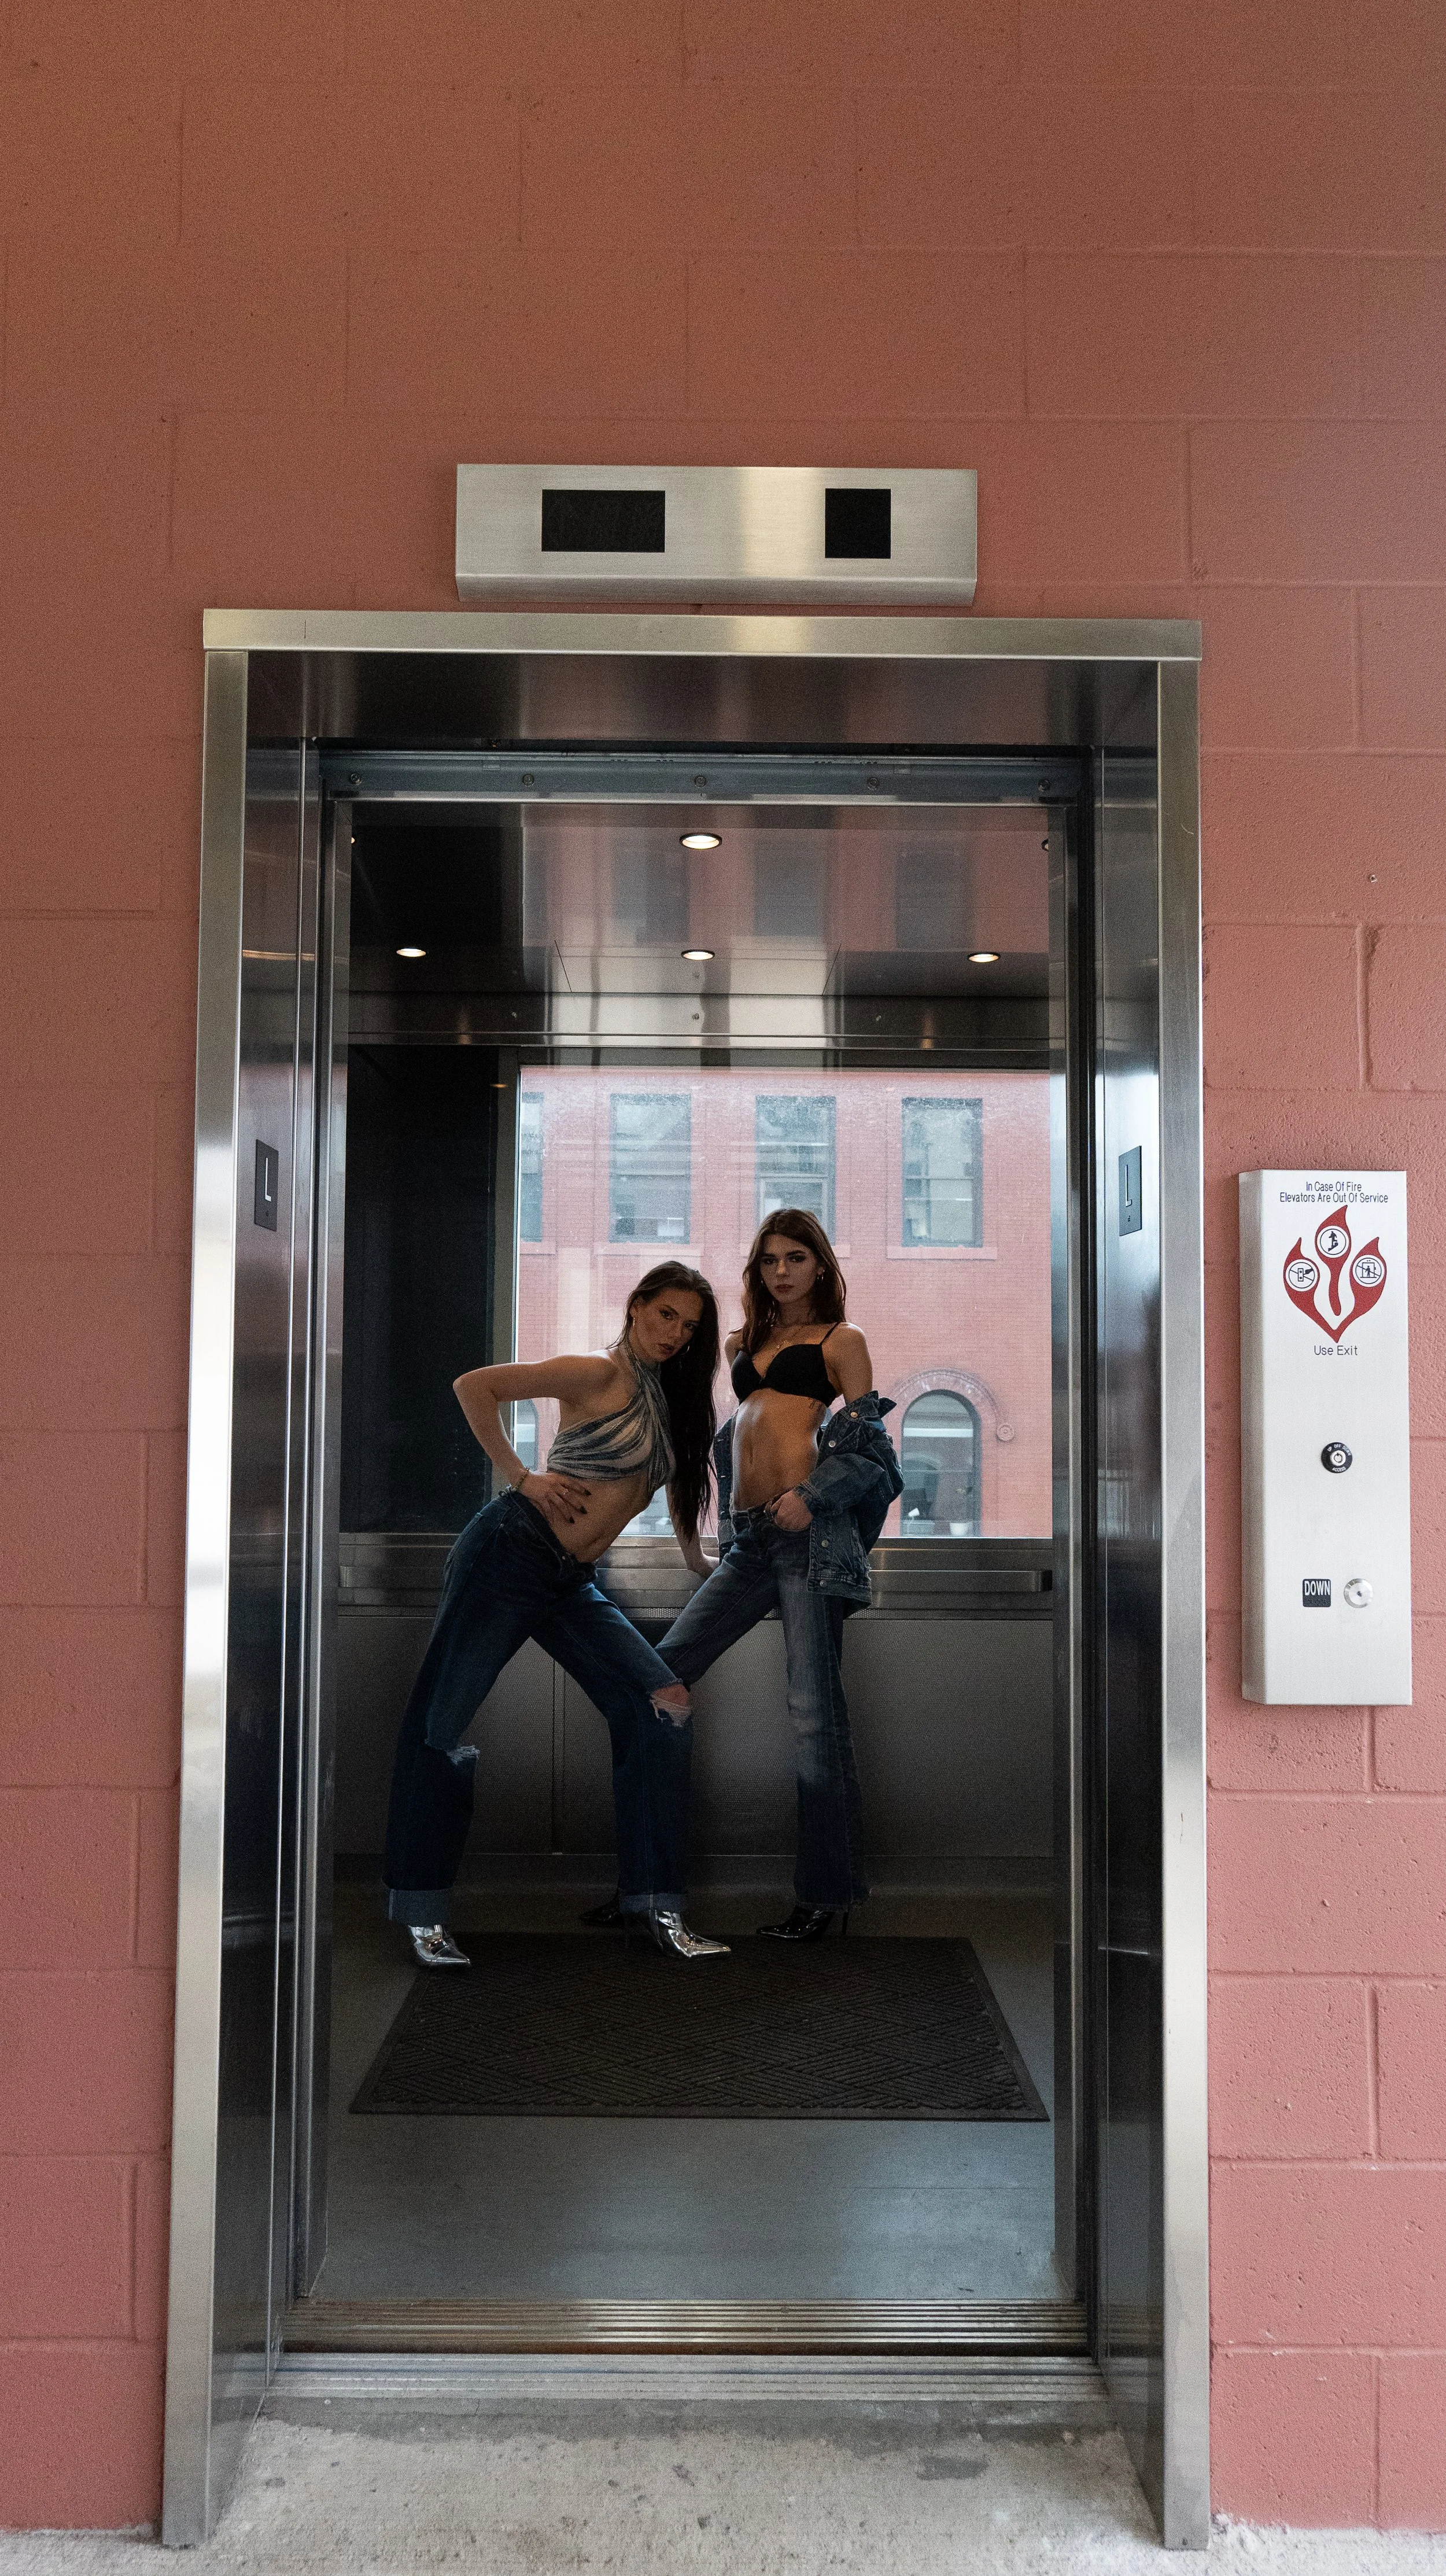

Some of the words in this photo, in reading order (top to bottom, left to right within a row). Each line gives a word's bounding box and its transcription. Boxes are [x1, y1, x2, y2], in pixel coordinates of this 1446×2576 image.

[264, 1157, 272, 1202] L
[1124, 1164, 1133, 1207] L
[1306, 1181, 1312, 1191] In
[1314, 1181, 1333, 1192] Case
[1336, 1181, 1344, 1192] Of
[1347, 1181, 1362, 1192] Fire
[1280, 1192, 1315, 1203] Elevators
[1317, 1193, 1331, 1203] Are
[1333, 1192, 1346, 1203] Out
[1348, 1192, 1357, 1203] Of
[1360, 1192, 1388, 1203] Service
[1314, 1345, 1333, 1355] Use
[1337, 1345, 1358, 1355] Exit
[1342, 1446, 1351, 1456] DOWN
[1304, 1580, 1330, 1595] DOWN
